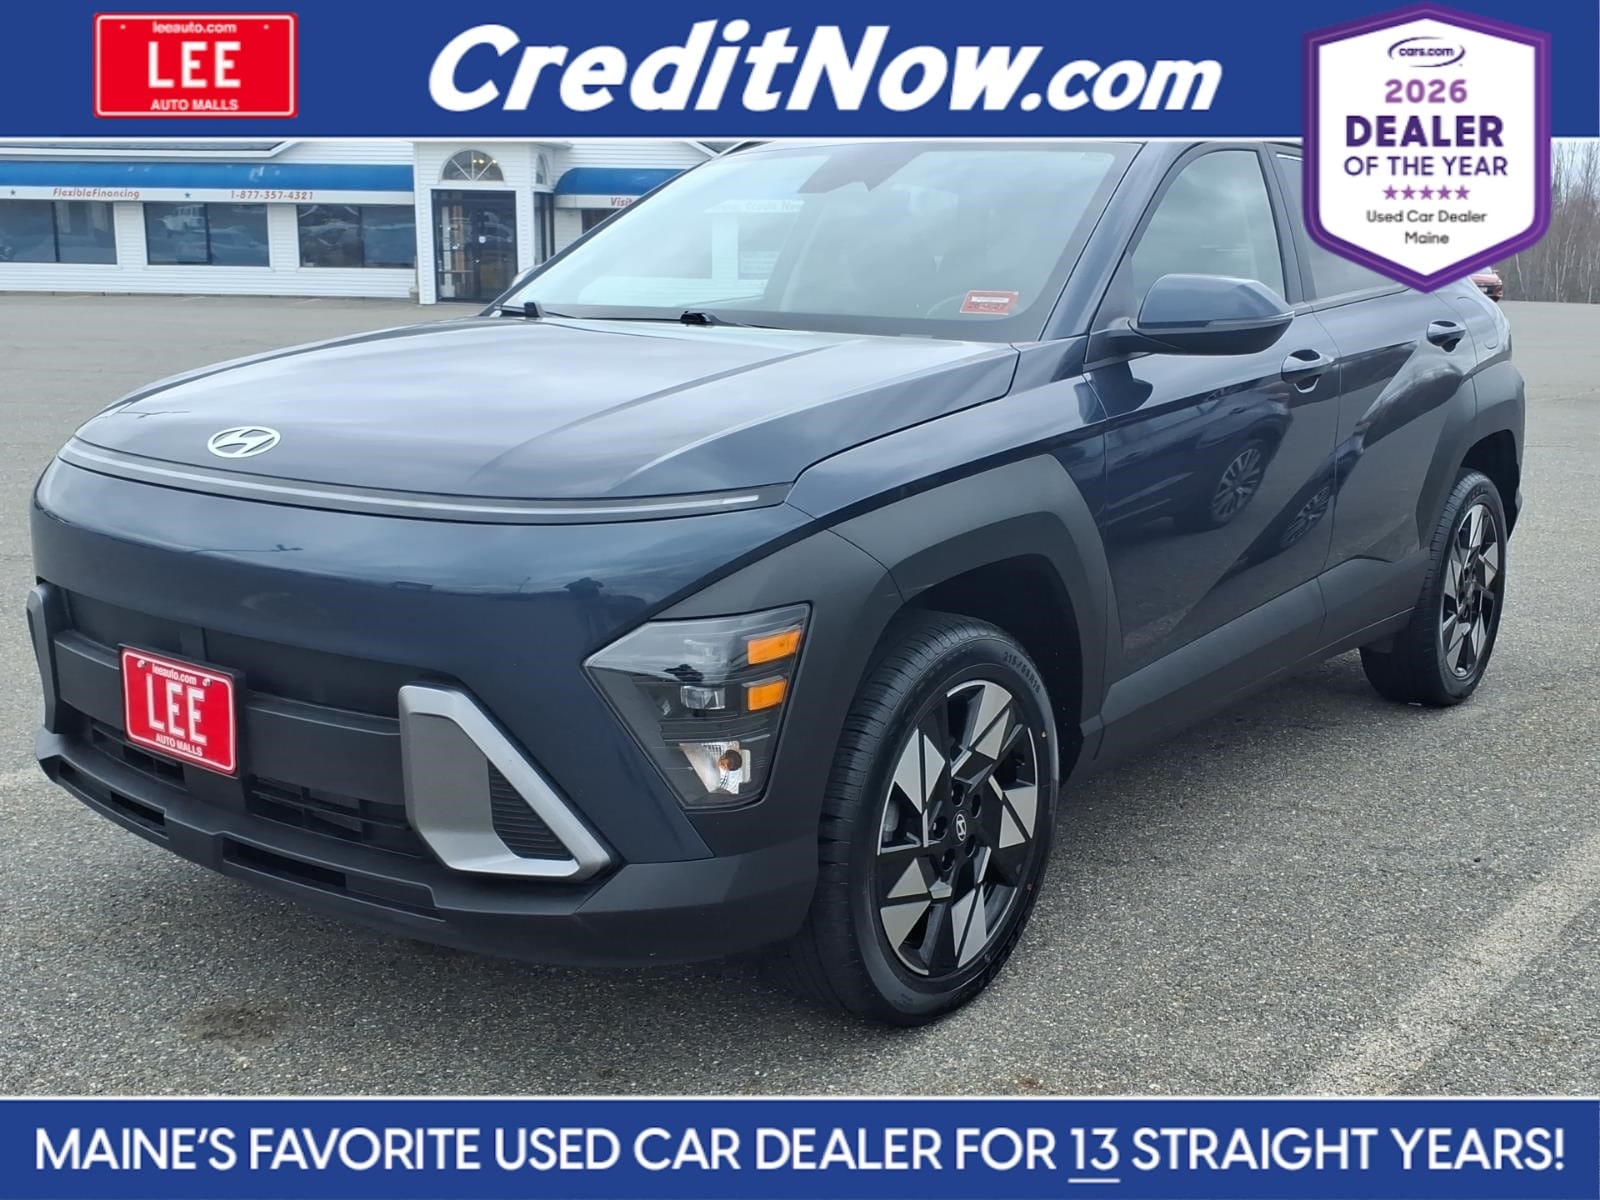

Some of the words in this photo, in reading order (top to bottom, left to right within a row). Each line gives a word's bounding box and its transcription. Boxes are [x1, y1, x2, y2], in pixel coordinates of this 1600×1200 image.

[231, 190, 314, 201] 1-877-357-4321
[152, 663, 197, 685] leeauto.com
[146, 673, 207, 745] LEE
[155, 733, 176, 747] AUTO
[176, 742, 203, 756] MALLS
